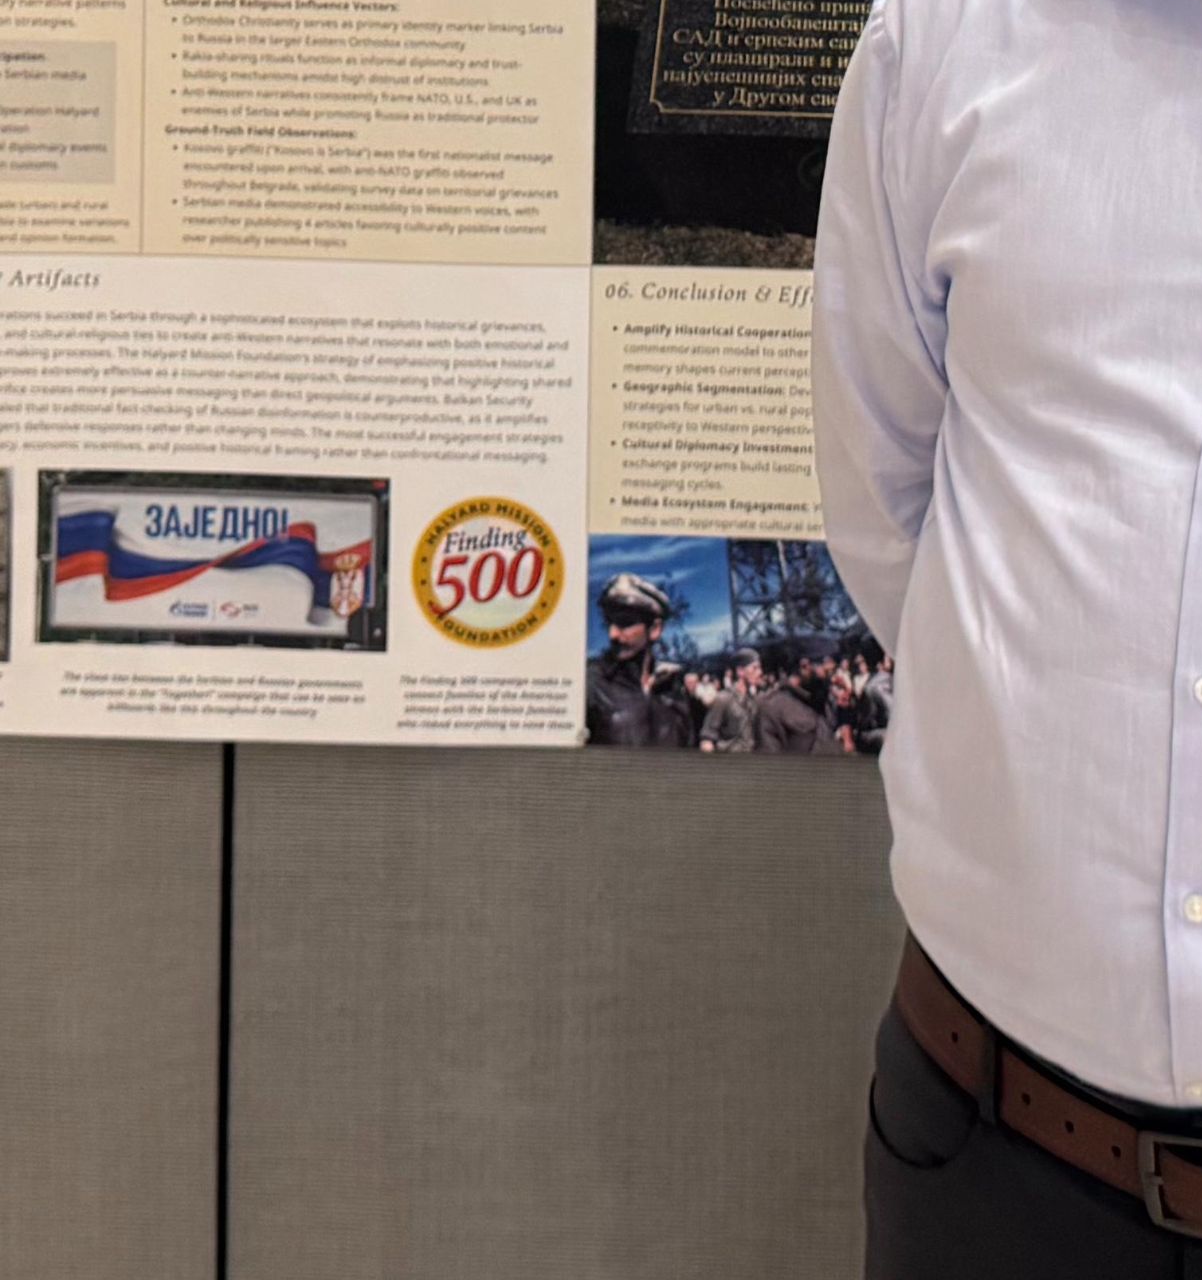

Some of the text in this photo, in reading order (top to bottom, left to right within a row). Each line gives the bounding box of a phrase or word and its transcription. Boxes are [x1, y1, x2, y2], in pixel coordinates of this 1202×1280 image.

[351, 1, 399, 13] Vectors:
[8, 269, 101, 291] Artifacts
[604, 281, 633, 299] 06.
[641, 281, 747, 302] Conclusion
[754, 284, 772, 303] &
[623, 323, 672, 338] Amplify
[674, 324, 734, 337] Historical
[621, 437, 813, 455] Cultural Diplomacy Investment
[146, 504, 289, 542] ЗАЈЕДНО!
[427, 503, 550, 546] HALYARD MISSION
[444, 527, 528, 553] Finding
[428, 546, 545, 618] 500
